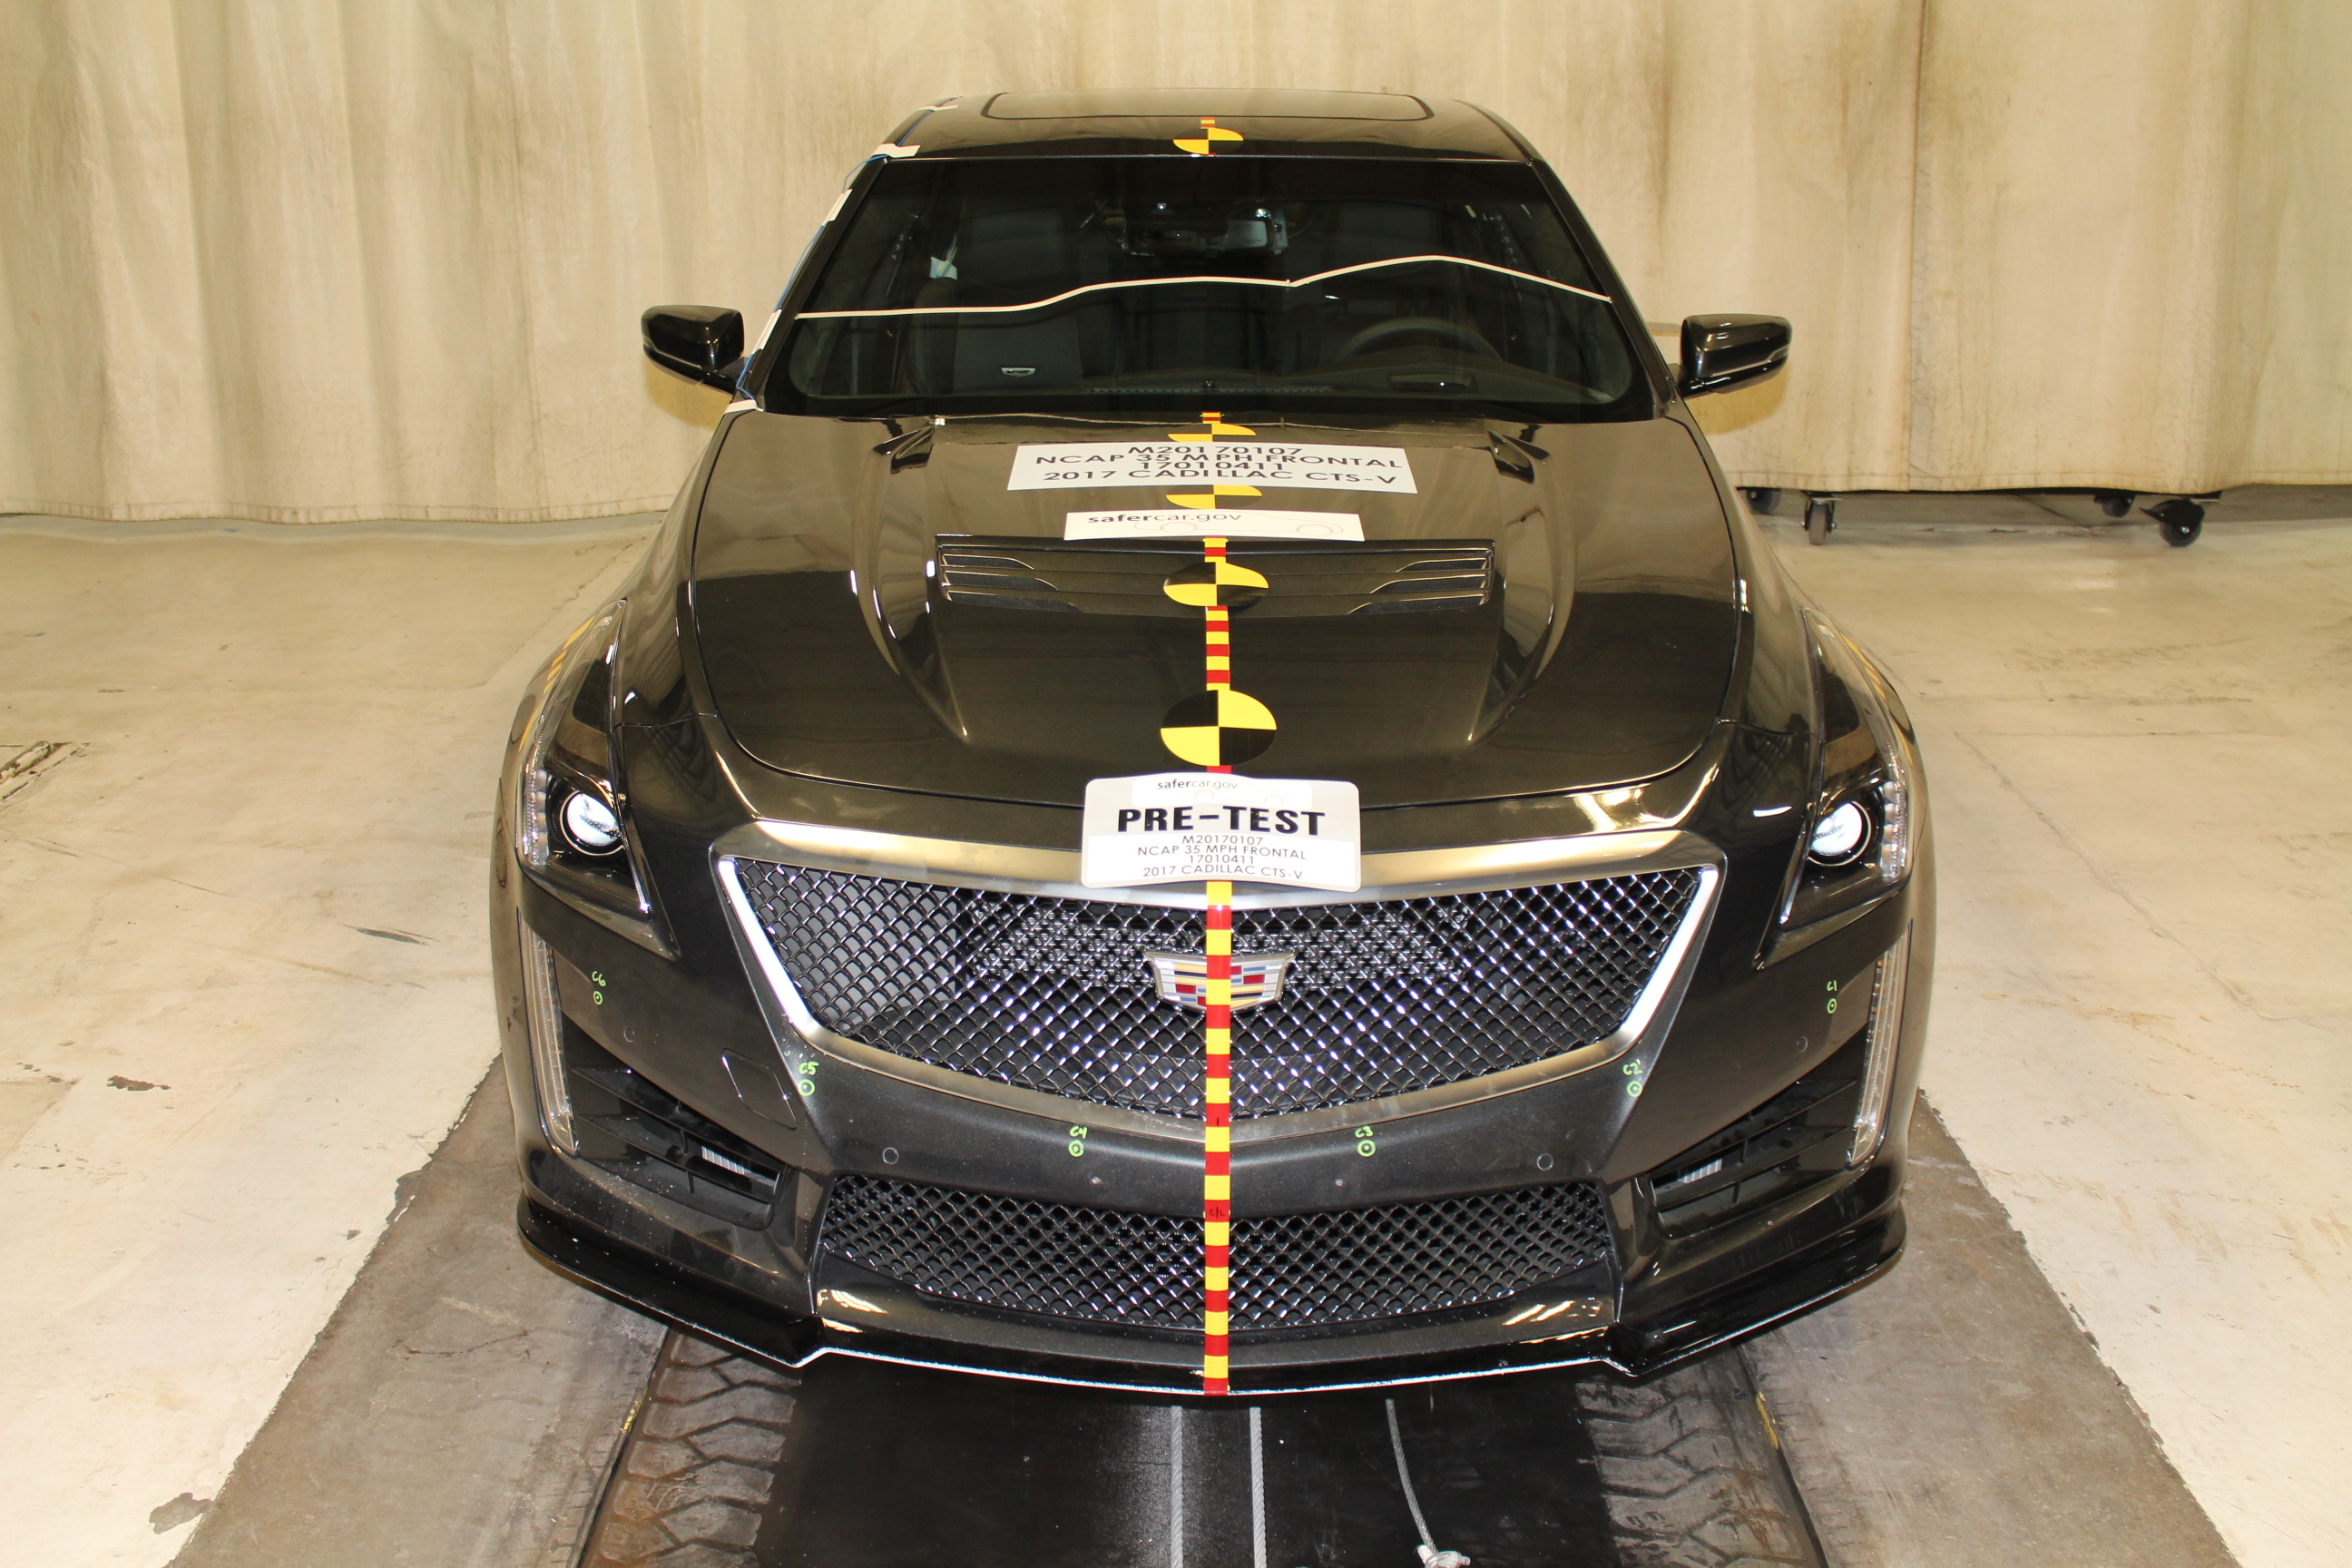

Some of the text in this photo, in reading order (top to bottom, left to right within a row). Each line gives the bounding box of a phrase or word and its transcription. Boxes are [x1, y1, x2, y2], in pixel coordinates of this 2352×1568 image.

[1128, 446, 1303, 456] M20170107
[1035, 453, 1403, 468] NCAP 35 MPH FRONTAL
[1140, 461, 1284, 471] 17010411
[1043, 469, 1396, 485] 2017 CADILLAC CTS-V
[1088, 514, 1241, 524] safercar.gov
[1157, 779, 1239, 790] safercar.gov
[1117, 805, 1327, 837] PRE-TEST
[1181, 834, 1264, 846] M20170107
[1137, 844, 1307, 860] NCAP 35 MPH FRONTAL
[1189, 854, 1254, 865] 17010411
[1142, 864, 1303, 880] 2017 CADILLAC CTS-V
[592, 970, 607, 987] C6
[1827, 979, 1838, 992] C1
[799, 1061, 819, 1076] C5
[1622, 1062, 1643, 1076] C2
[1069, 1125, 1088, 1140] C4
[1355, 1125, 1374, 1139] C3
